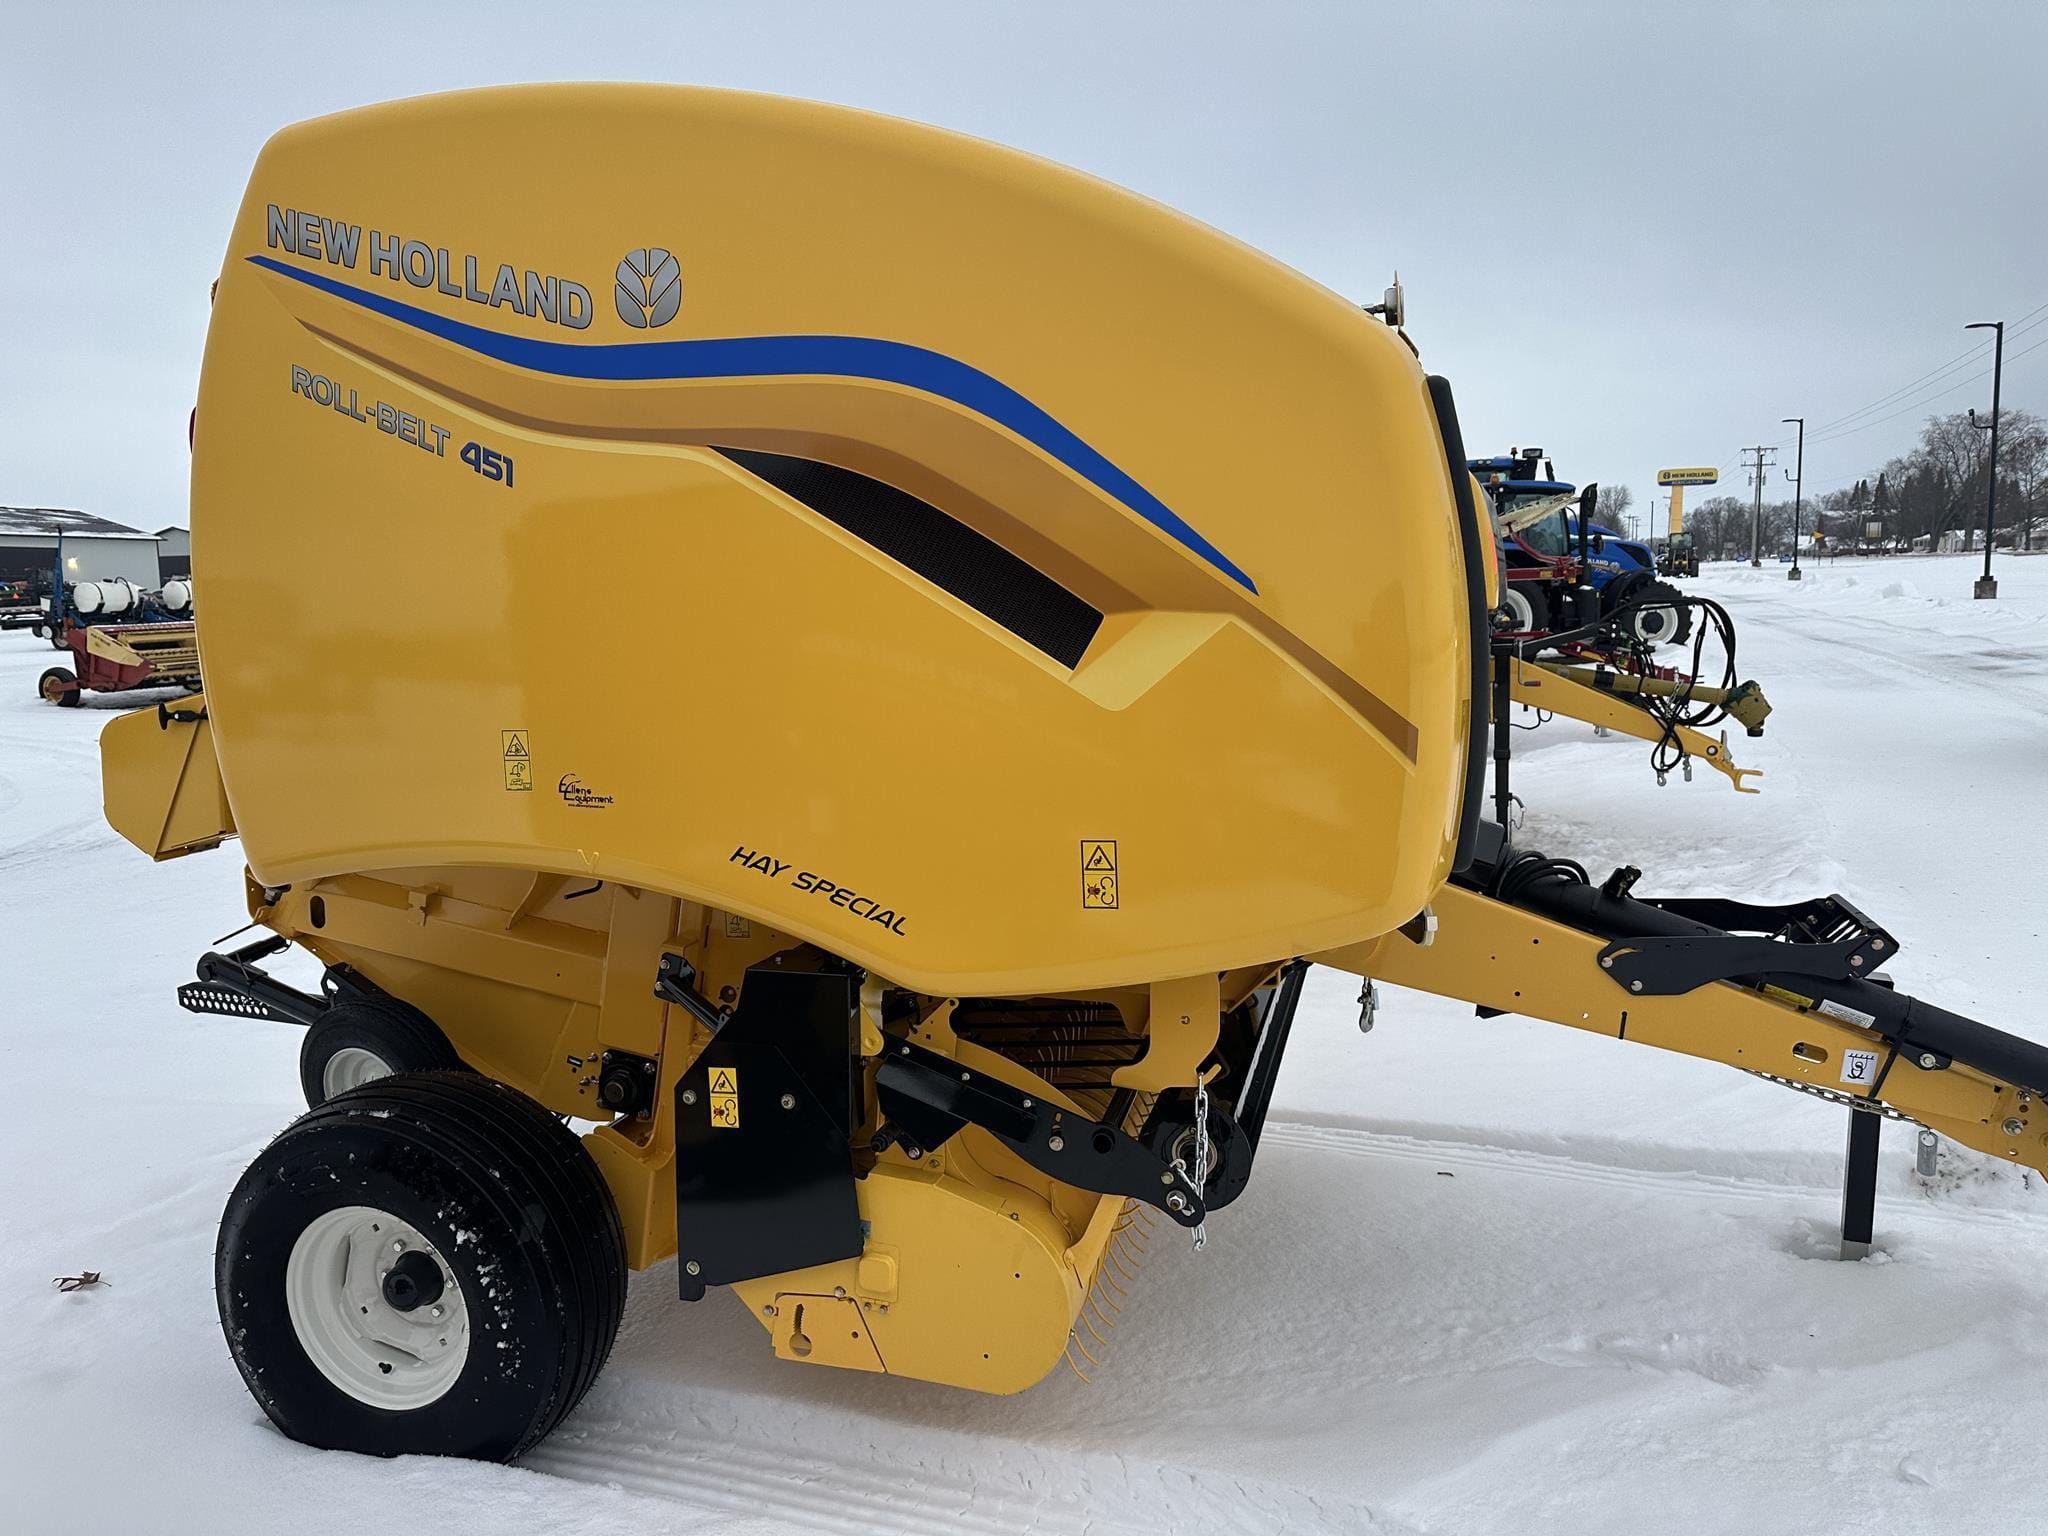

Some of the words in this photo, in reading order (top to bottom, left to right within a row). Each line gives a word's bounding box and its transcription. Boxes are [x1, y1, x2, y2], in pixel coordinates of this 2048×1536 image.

[267, 203, 361, 269] NEW
[369, 229, 594, 330] HOLLAND
[291, 363, 451, 458] ROLL-BELT
[460, 441, 514, 488] 451
[729, 846, 792, 878] HAY
[791, 871, 907, 937] SPECIAL
